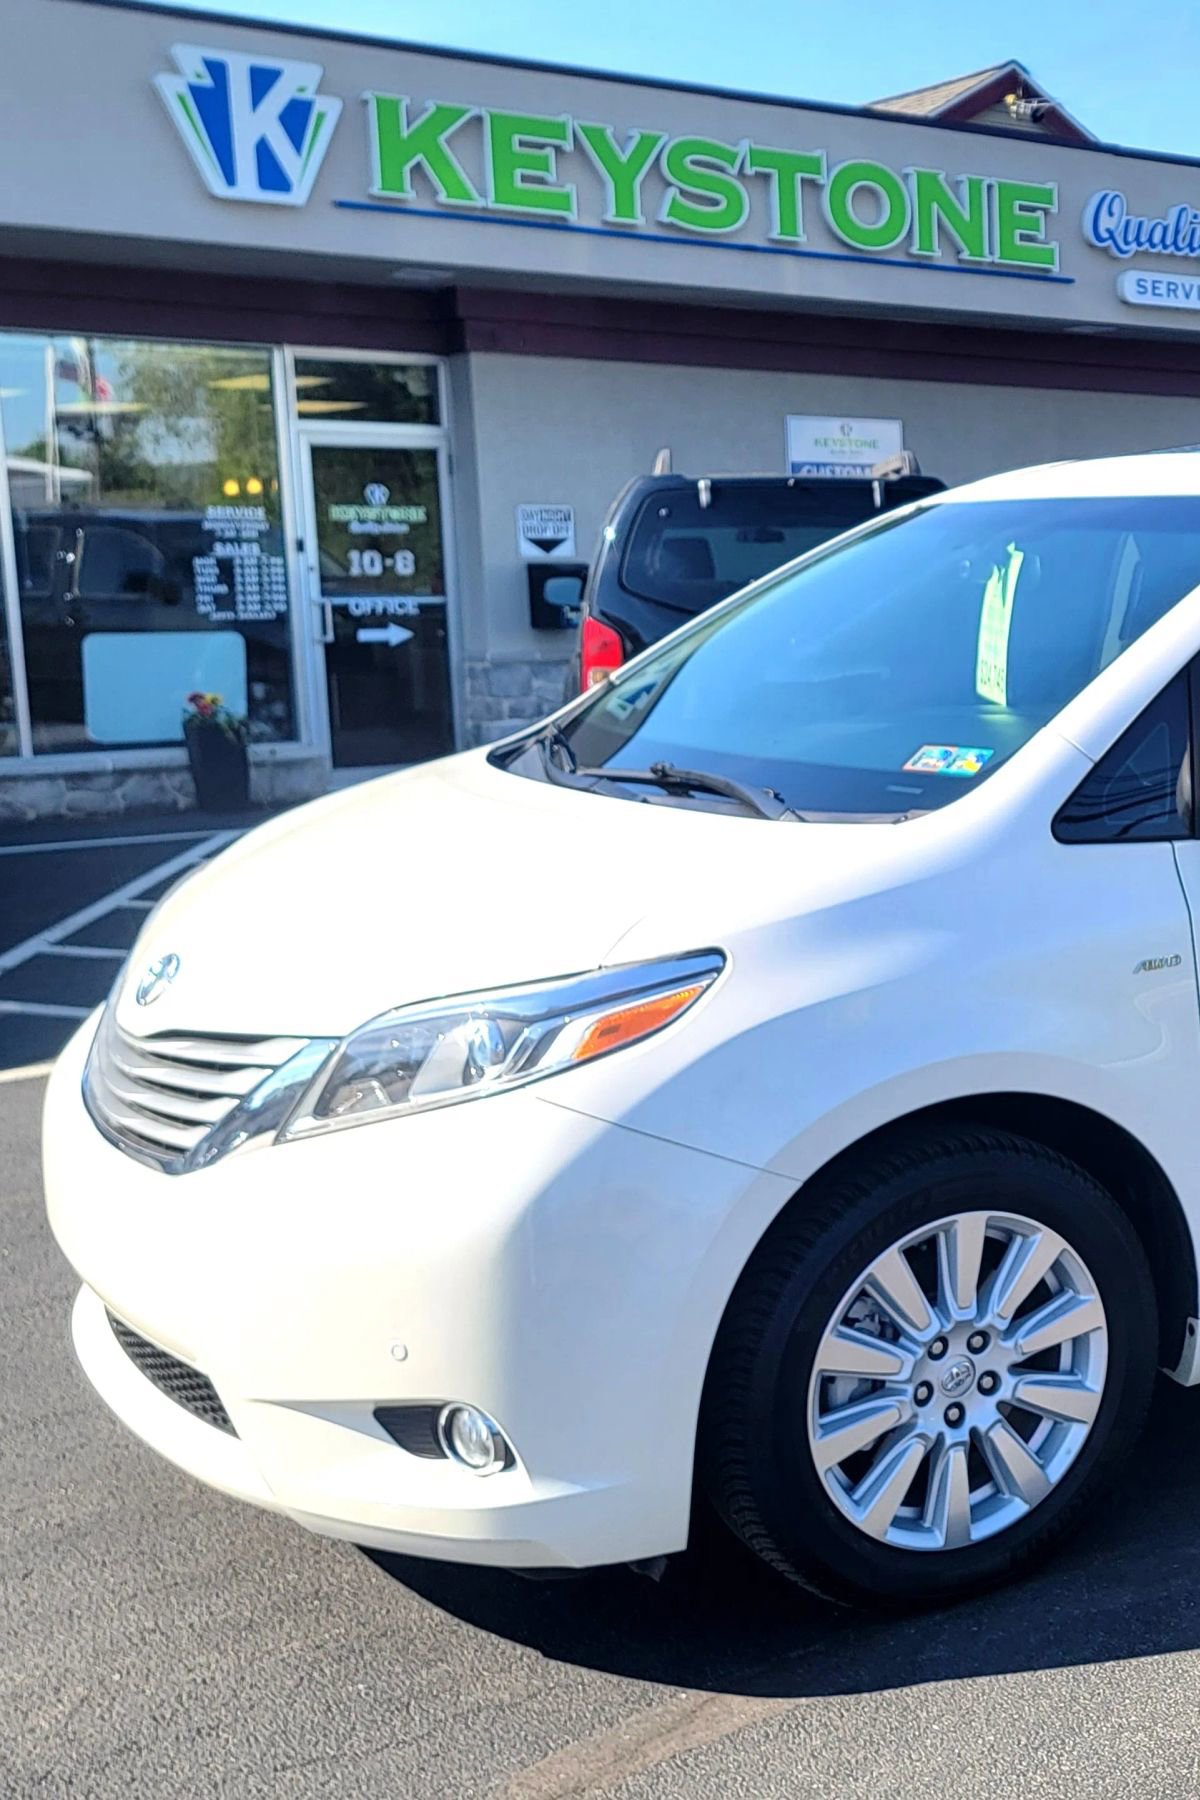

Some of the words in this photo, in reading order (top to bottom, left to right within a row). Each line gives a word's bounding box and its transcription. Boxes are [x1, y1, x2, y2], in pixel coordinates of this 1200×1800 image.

[362, 90, 1059, 272] KEYSTONE
[814, 437, 880, 450] KEYSTONE
[206, 505, 266, 519] SERVICE
[347, 597, 420, 616] OFFICE
